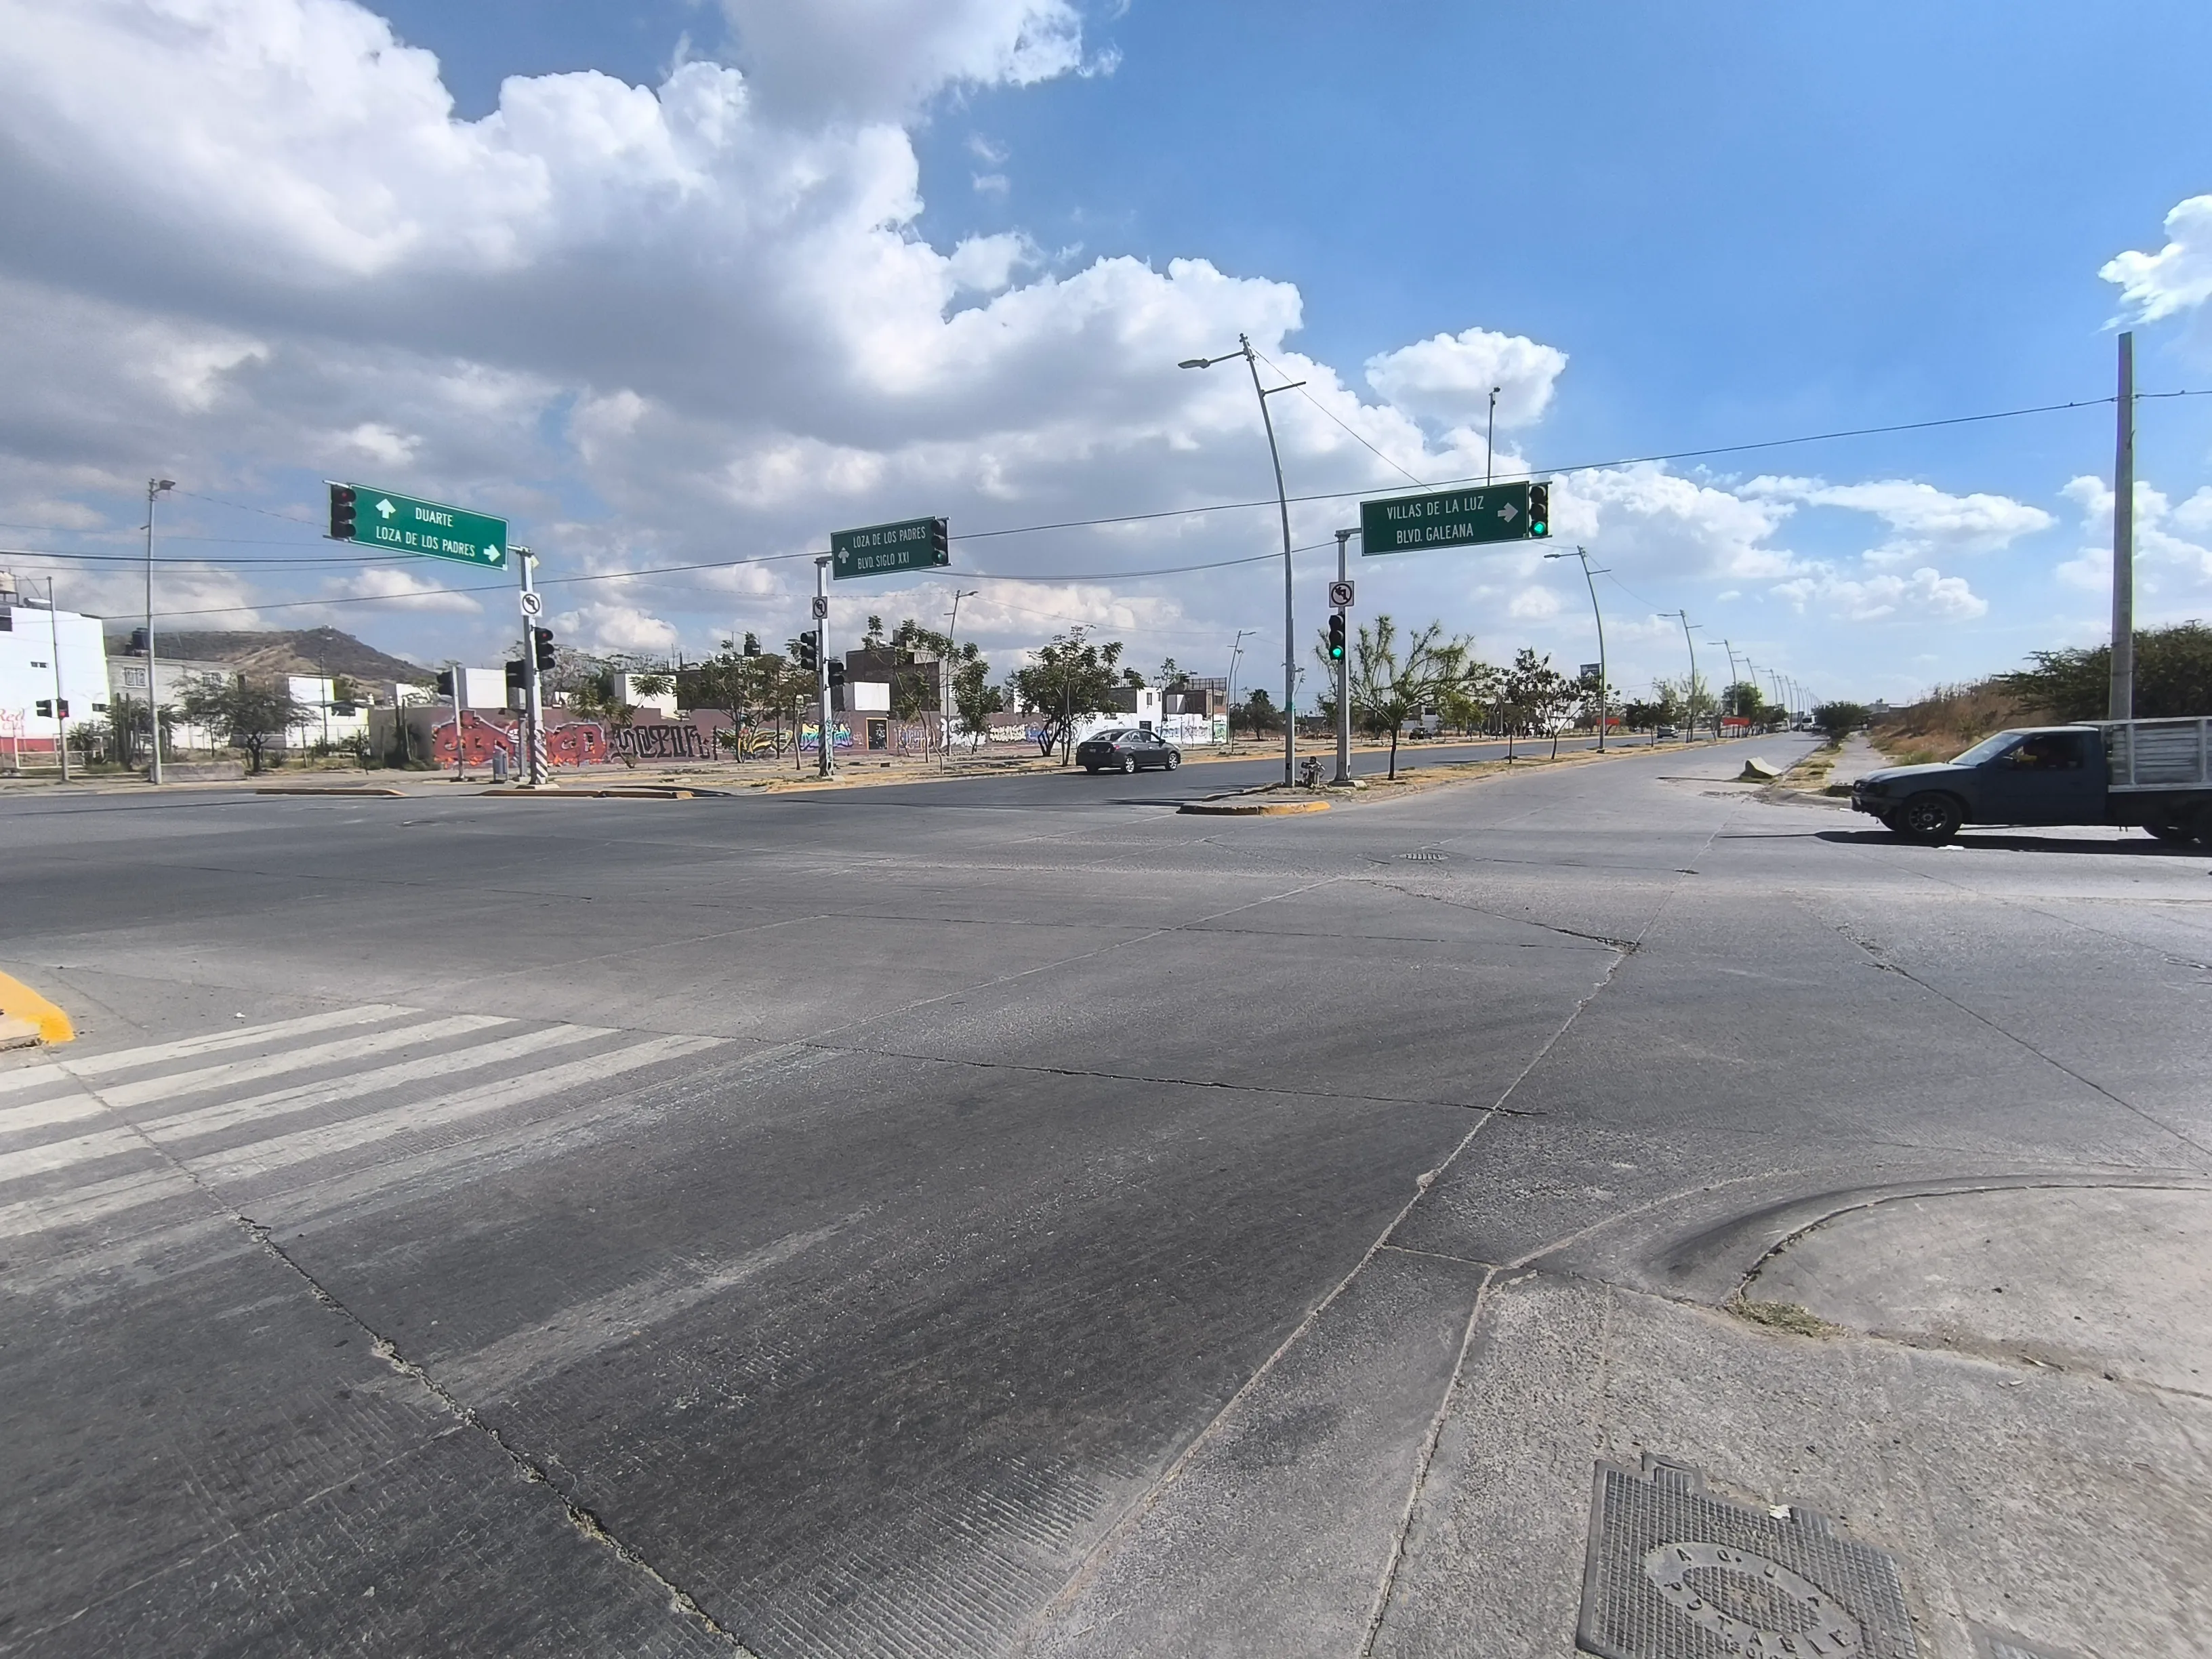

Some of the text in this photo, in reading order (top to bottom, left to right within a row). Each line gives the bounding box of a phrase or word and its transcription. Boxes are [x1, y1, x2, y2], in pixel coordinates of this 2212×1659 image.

[415, 507, 453, 527] DUARTE
[1387, 495, 1484, 520] VILLAS DE LA LUZ
[375, 525, 475, 557] LOZA DE LOS PADRES
[853, 526, 926, 548] LOZA DE LOS PADRES
[1396, 523, 1474, 544] BLVD. GALEANA
[857, 551, 910, 570] BLVD. SIGLO XXI
